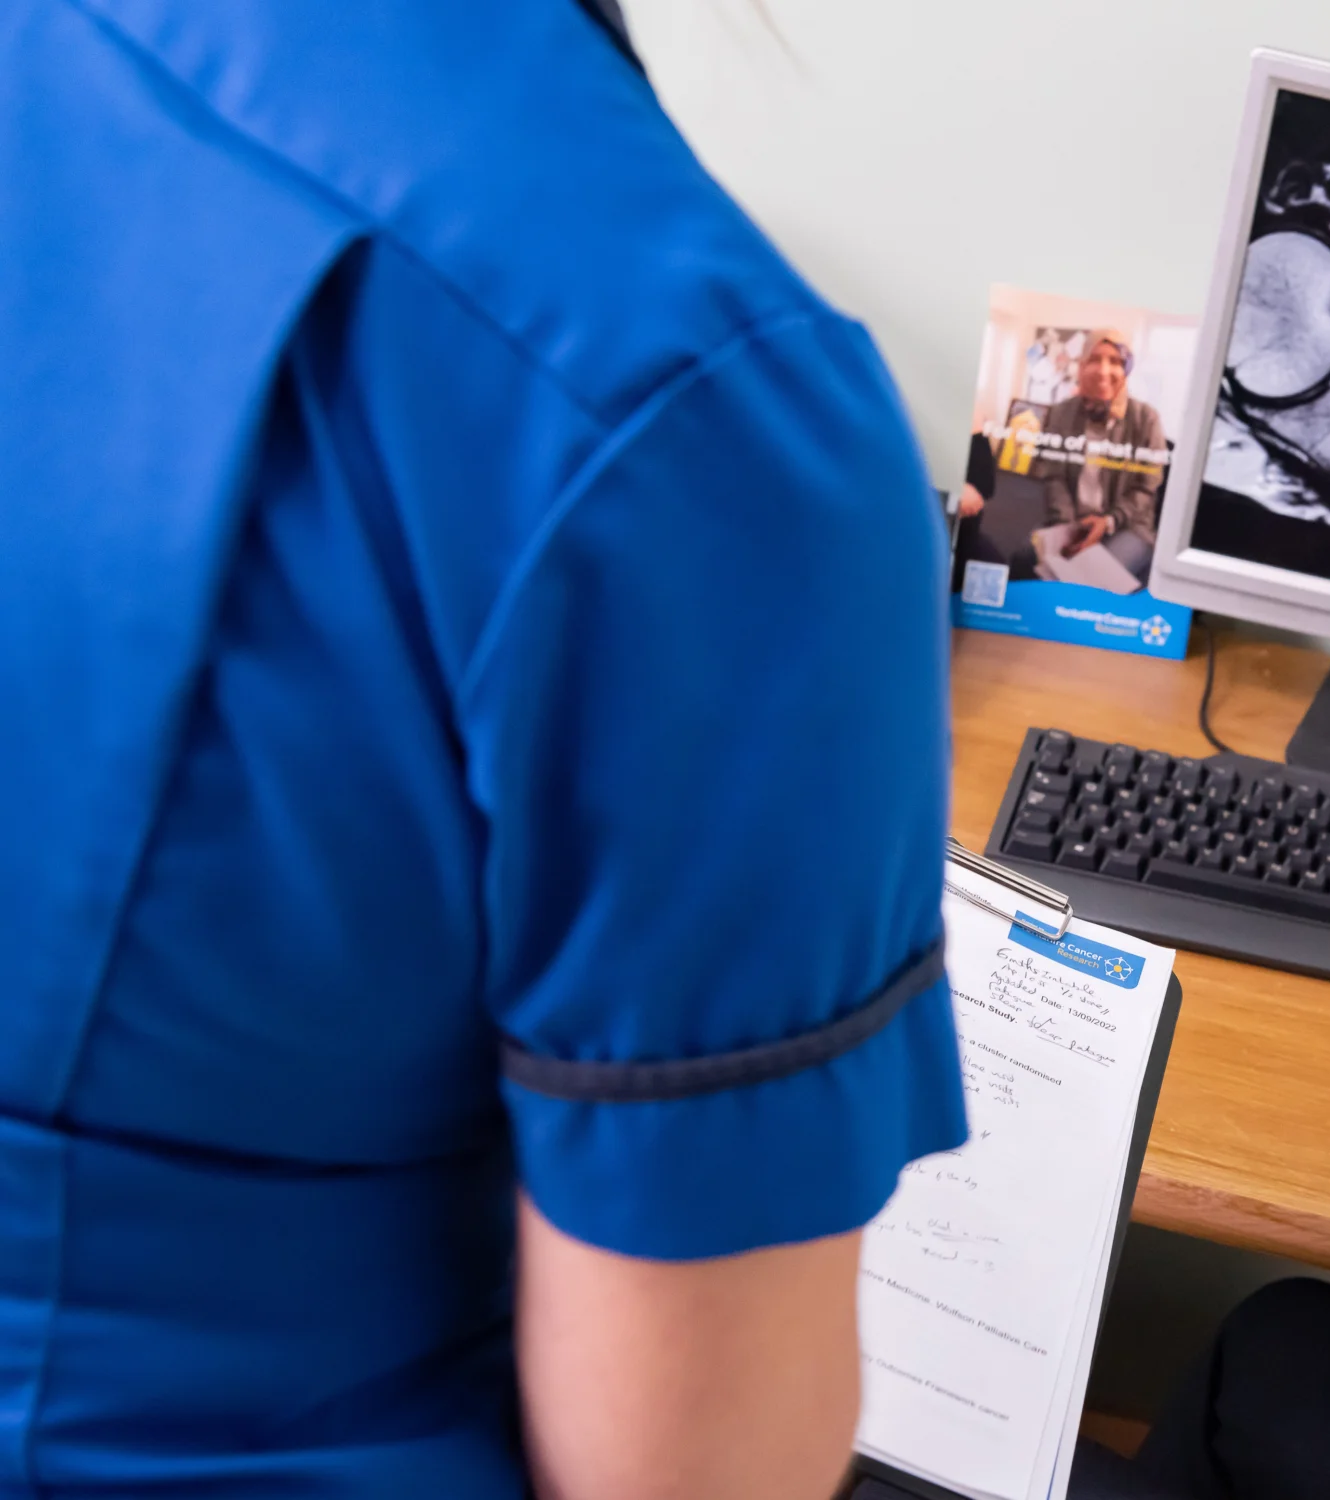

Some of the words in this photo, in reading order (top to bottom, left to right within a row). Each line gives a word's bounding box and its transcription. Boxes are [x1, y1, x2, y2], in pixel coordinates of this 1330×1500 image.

[1057, 947, 1099, 969] Research
[1067, 943, 1103, 961] Cancer
[988, 1004, 1018, 1024] Study.
[1040, 995, 1064, 1010] Date:
[1067, 1008, 1117, 1033] 13/09/2022
[977, 1043, 1007, 1061] cluster
[1009, 1057, 1063, 1086] randomised
[935, 1300, 976, 1326] Wolfson
[977, 1319, 1021, 1346] Palliative
[1023, 1340, 1048, 1357] Care
